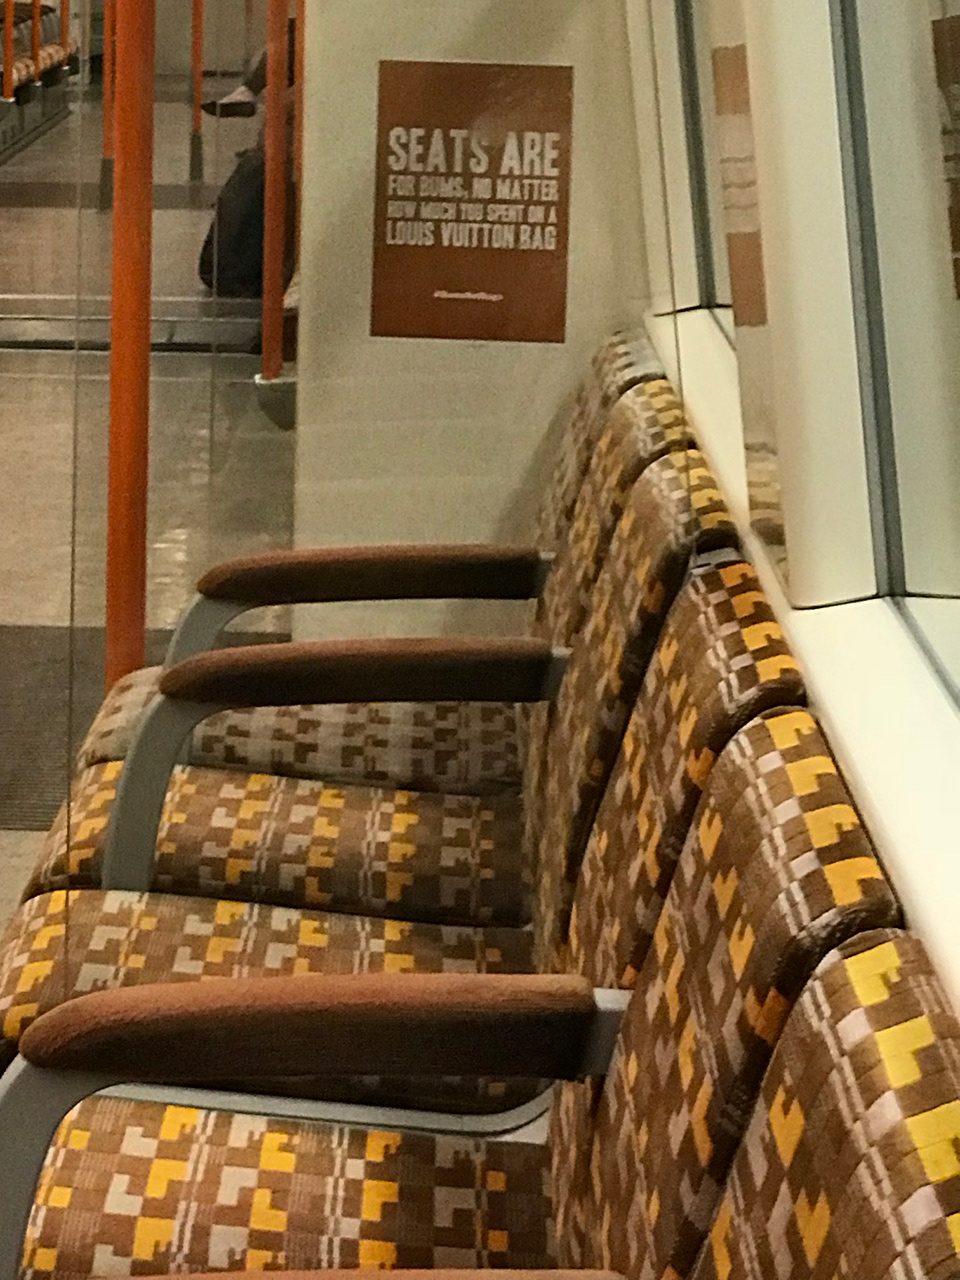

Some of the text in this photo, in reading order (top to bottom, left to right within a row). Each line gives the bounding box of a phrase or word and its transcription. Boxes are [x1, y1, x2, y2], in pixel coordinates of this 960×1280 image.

[388, 126, 560, 176] SEATS ARE
[387, 174, 416, 196] FOR
[495, 178, 558, 201] MATTER
[487, 204, 525, 223] SPENT
[527, 205, 545, 223] ON
[547, 206, 558, 224] A
[386, 221, 557, 250] LOUIS VUITTON BAG
